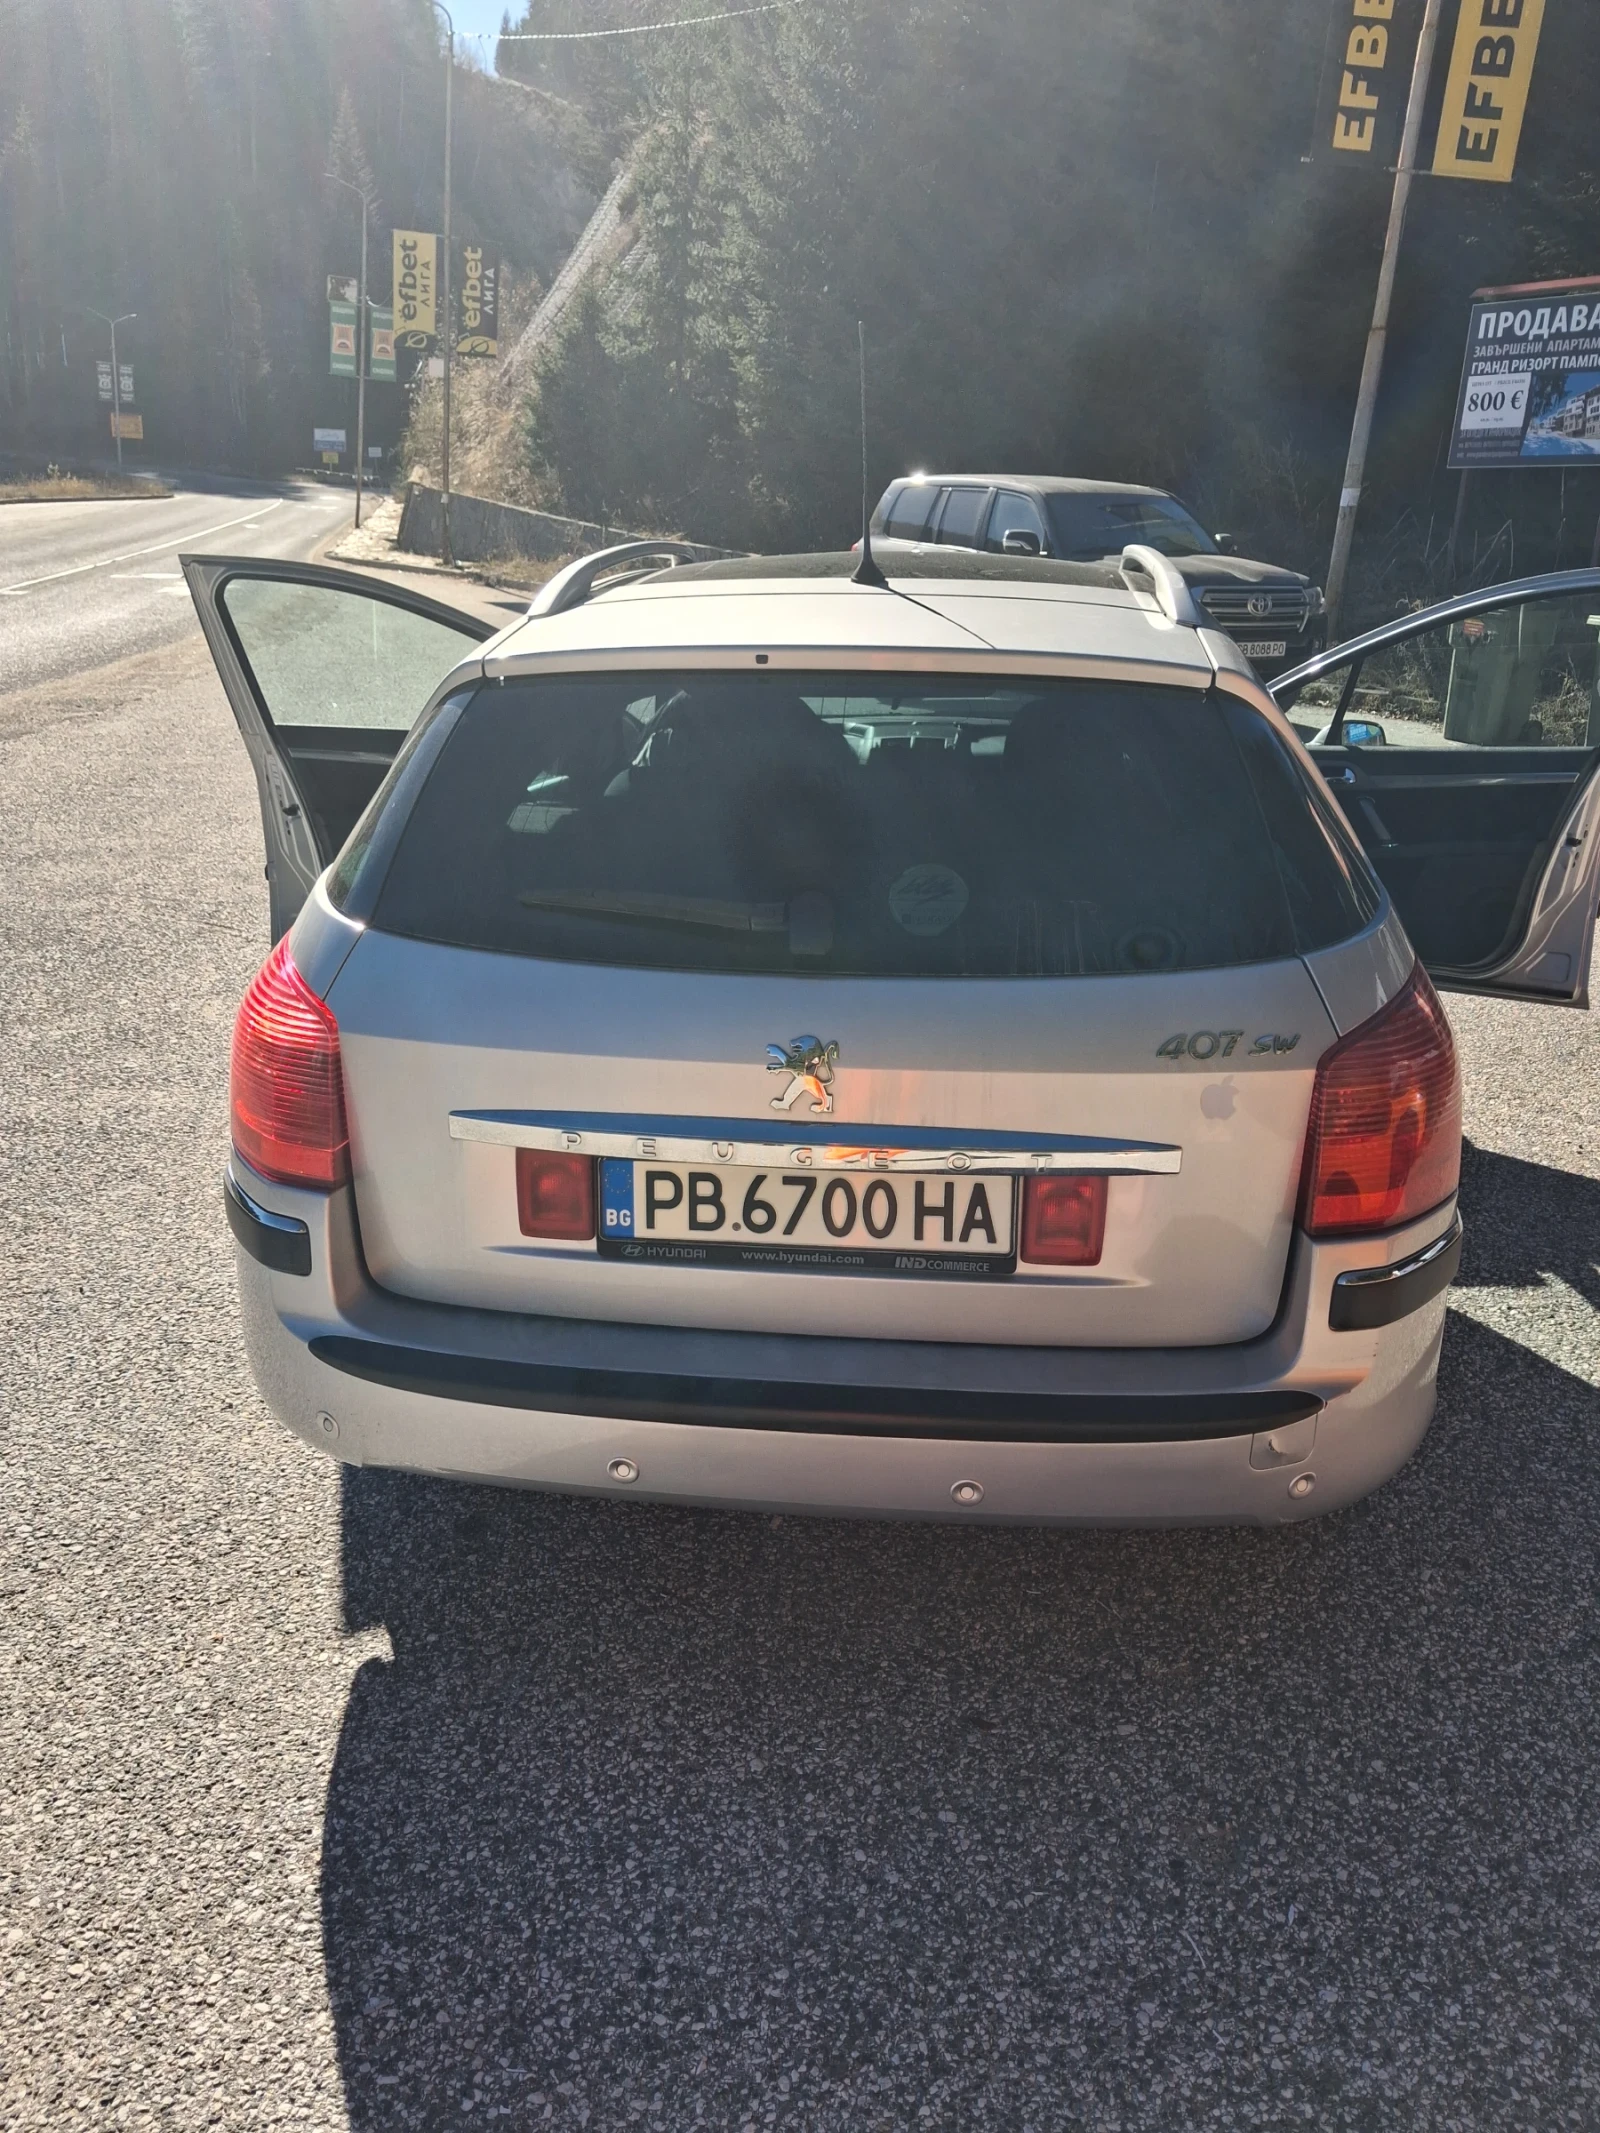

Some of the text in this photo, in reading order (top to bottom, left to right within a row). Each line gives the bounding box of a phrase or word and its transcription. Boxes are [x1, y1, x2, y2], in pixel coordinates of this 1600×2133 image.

[399, 239, 418, 321] efbet
[420, 260, 431, 308] ЛИГА
[462, 246, 483, 328] efbet
[483, 267, 496, 315] ЛИГА
[1473, 341, 1543, 358] ЗАВЪРШЕНИ
[1471, 354, 1600, 375] ГРАНД РИЗОРТ ПАМП
[1467, 390, 1524, 412] 800 €
[1249, 644, 1271, 655] 8088
[1156, 1030, 1301, 1060] 407 SW
[560, 1131, 1054, 1173] PEUGEOT
[606, 1208, 632, 1227] BG
[742, 1174, 898, 1239] 6700
[914, 1180, 998, 1245] HA
[647, 1246, 706, 1260] HYUNDAI
[741, 1250, 865, 1265] www.hyundai.com
